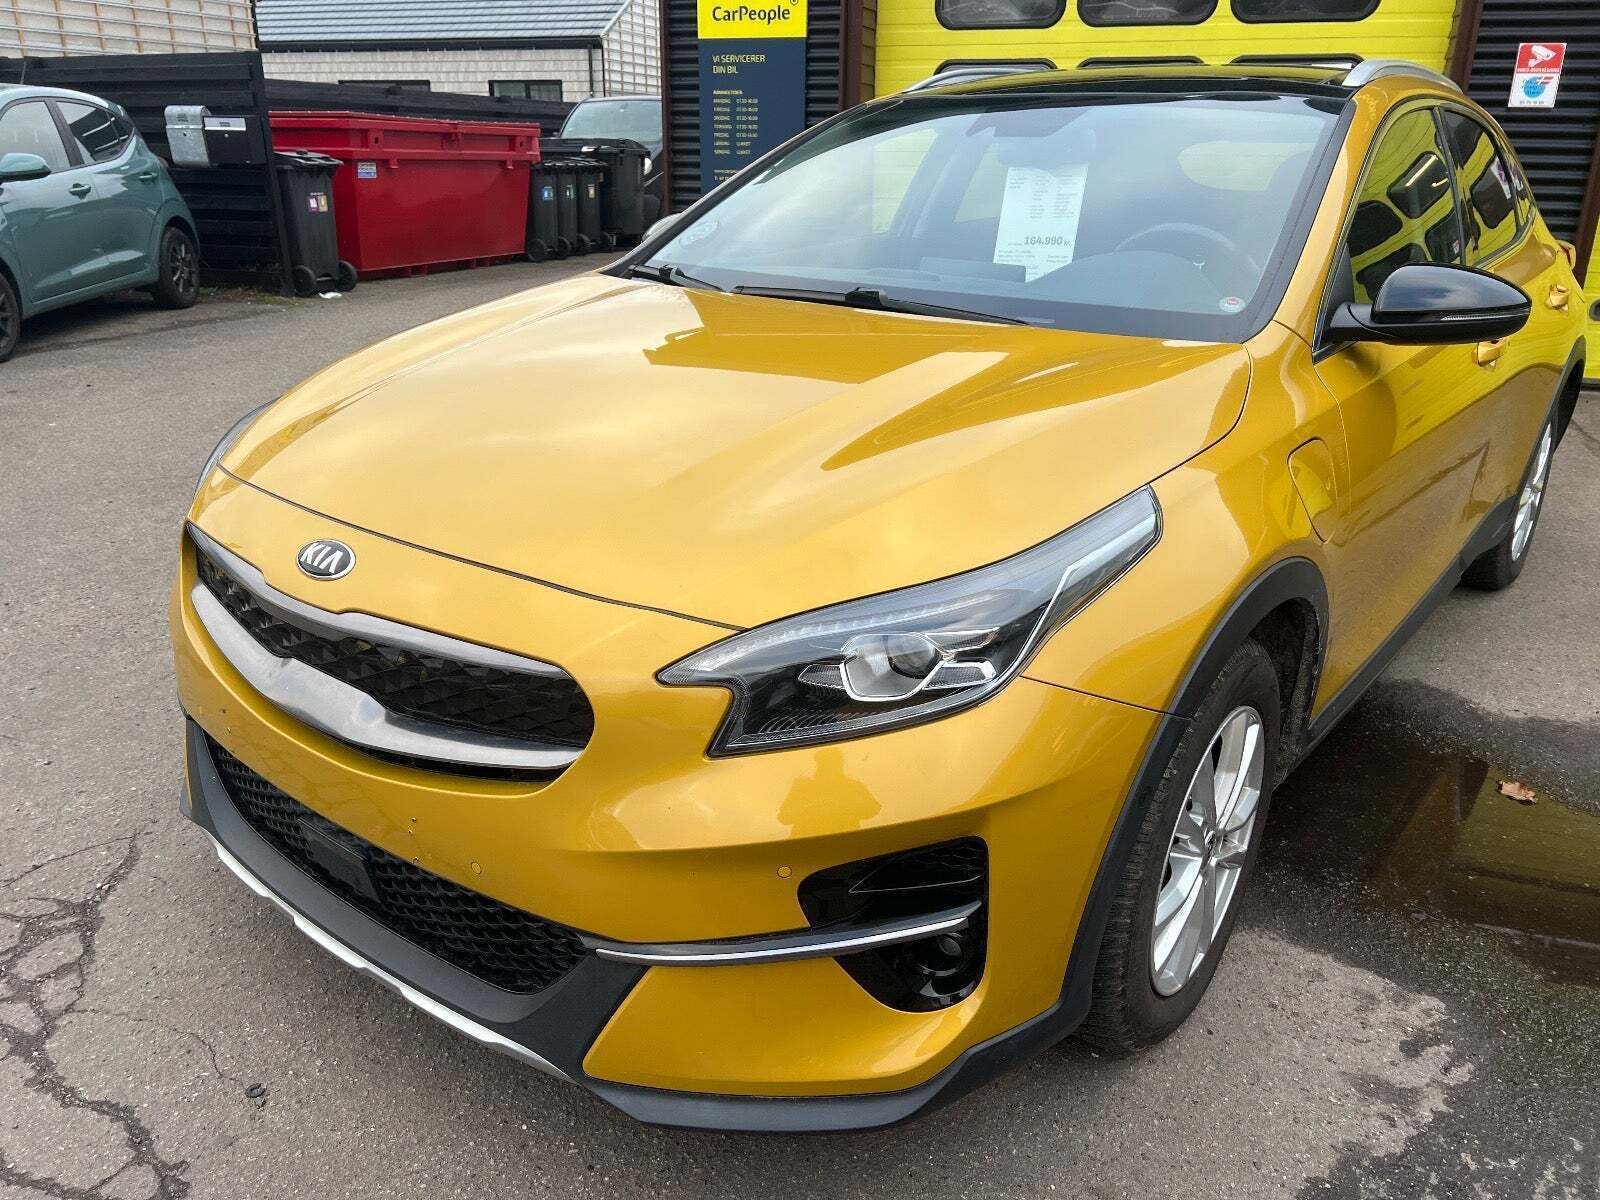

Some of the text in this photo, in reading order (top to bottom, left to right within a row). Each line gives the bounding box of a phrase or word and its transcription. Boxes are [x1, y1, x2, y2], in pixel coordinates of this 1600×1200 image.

[712, 5, 791, 25] CarPeople
[721, 54, 766, 63] SERVICERER
[712, 65, 739, 74] DIN BIL
[1024, 236, 1064, 246] 164.990
[300, 542, 344, 574] KIA
